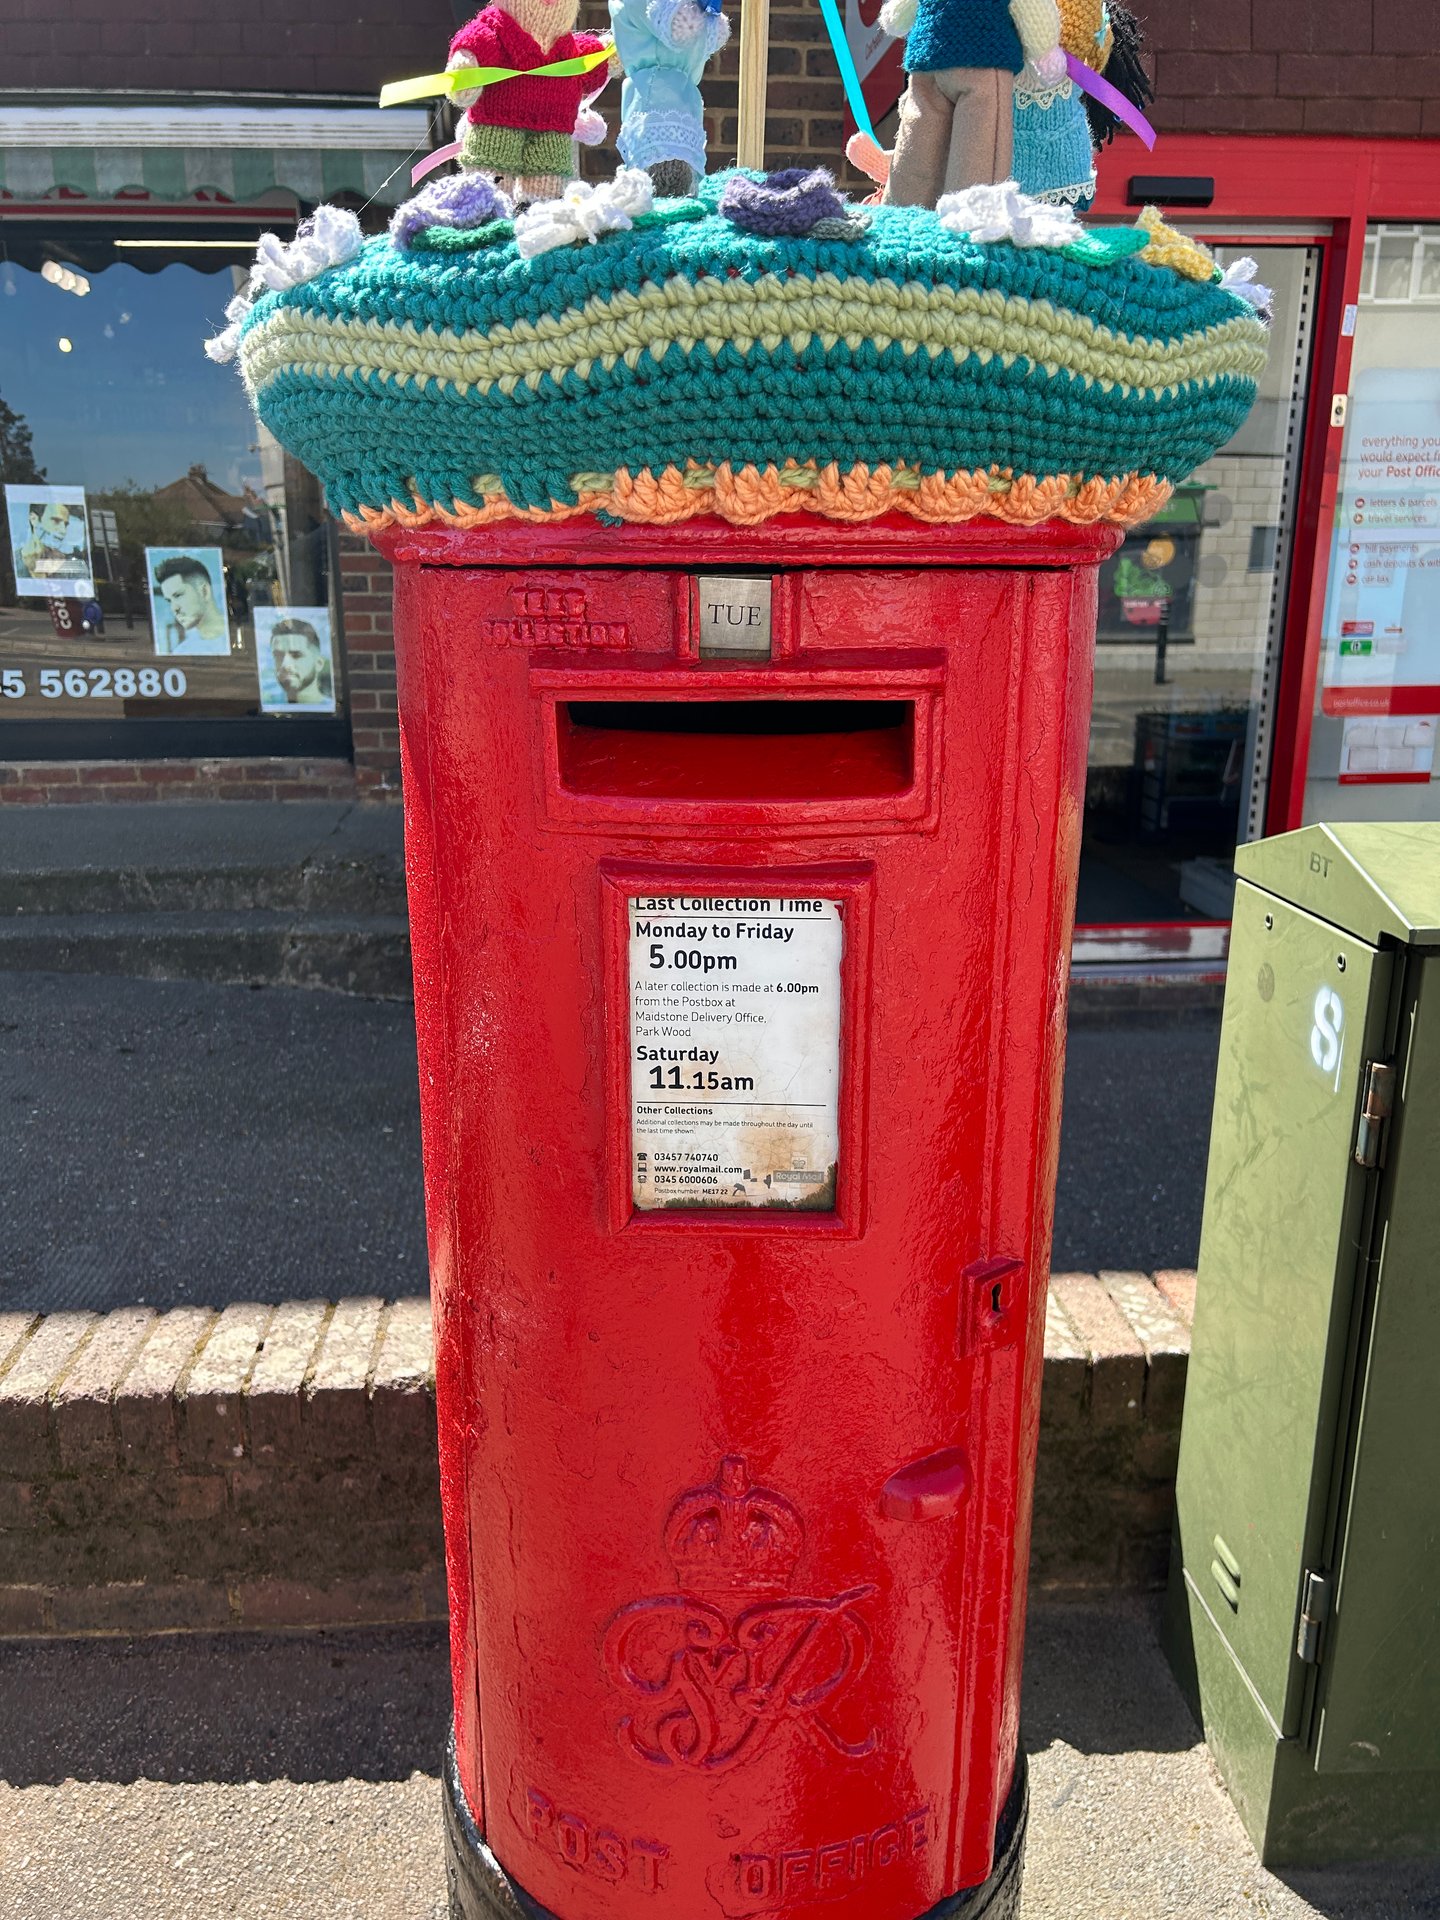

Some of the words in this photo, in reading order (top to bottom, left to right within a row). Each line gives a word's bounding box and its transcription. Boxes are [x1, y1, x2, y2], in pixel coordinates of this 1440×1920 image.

[1361, 435, 1418, 448] everything
[1360, 450, 1392, 462] would
[1395, 451, 1430, 463] expect
[1358, 468, 1383, 479] your
[1386, 465, 1411, 477] Post
[1370, 499, 1396, 507] letters
[1368, 514, 1392, 523] travel
[1394, 515, 1426, 523] services
[707, 603, 762, 627] TUE
[39, 667, 188, 699] 562880
[1310, 851, 1333, 879] BT
[635, 897, 675, 911] Last
[680, 898, 771, 912] Collection
[635, 922, 708, 942] Monday
[712, 924, 731, 938] to
[736, 923, 795, 943] Friday
[649, 944, 738, 974] 5.00pm
[634, 981, 643, 991] A
[645, 981, 668, 992] later
[671, 982, 719, 992] collection
[722, 983, 730, 992] is
[732, 983, 762, 993] made
[764, 984, 774, 993] at
[776, 982, 819, 995] 6.00pm
[635, 996, 661, 1006] from
[663, 997, 679, 1007] the
[682, 997, 723, 1007] Postbox
[725, 998, 736, 1007] at
[635, 1011, 689, 1022] Maidstone
[691, 1012, 733, 1024] Delivery
[735, 1012, 767, 1024] Office,
[635, 1026, 660, 1037] Park
[662, 1027, 691, 1037] Wood
[636, 1045, 720, 1064] Saturday
[649, 1065, 754, 1091] 11.15am
[636, 1106, 663, 1115] Other
[664, 1106, 713, 1115] Collections
[636, 1118, 667, 1127] Additional
[668, 1119, 700, 1127] collections
[700, 1120, 711, 1128] may
[712, 1119, 722, 1127] be
[723, 1119, 740, 1127] made
[741, 1120, 775, 1129] throughout
[787, 1121, 799, 1130] day
[800, 1121, 814, 1129] until
[654, 1152, 682, 1162] 03457
[684, 1153, 719, 1162] 740740
[654, 1165, 743, 1175] www.royalmail.com
[654, 1175, 677, 1184] 0345
[678, 1175, 719, 1184] 6000606
[776, 1172, 800, 1182] Royal
[677, 1187, 700, 1195] number
[526, 1785, 672, 1891] POST
[735, 1804, 931, 1900] OFFICE
